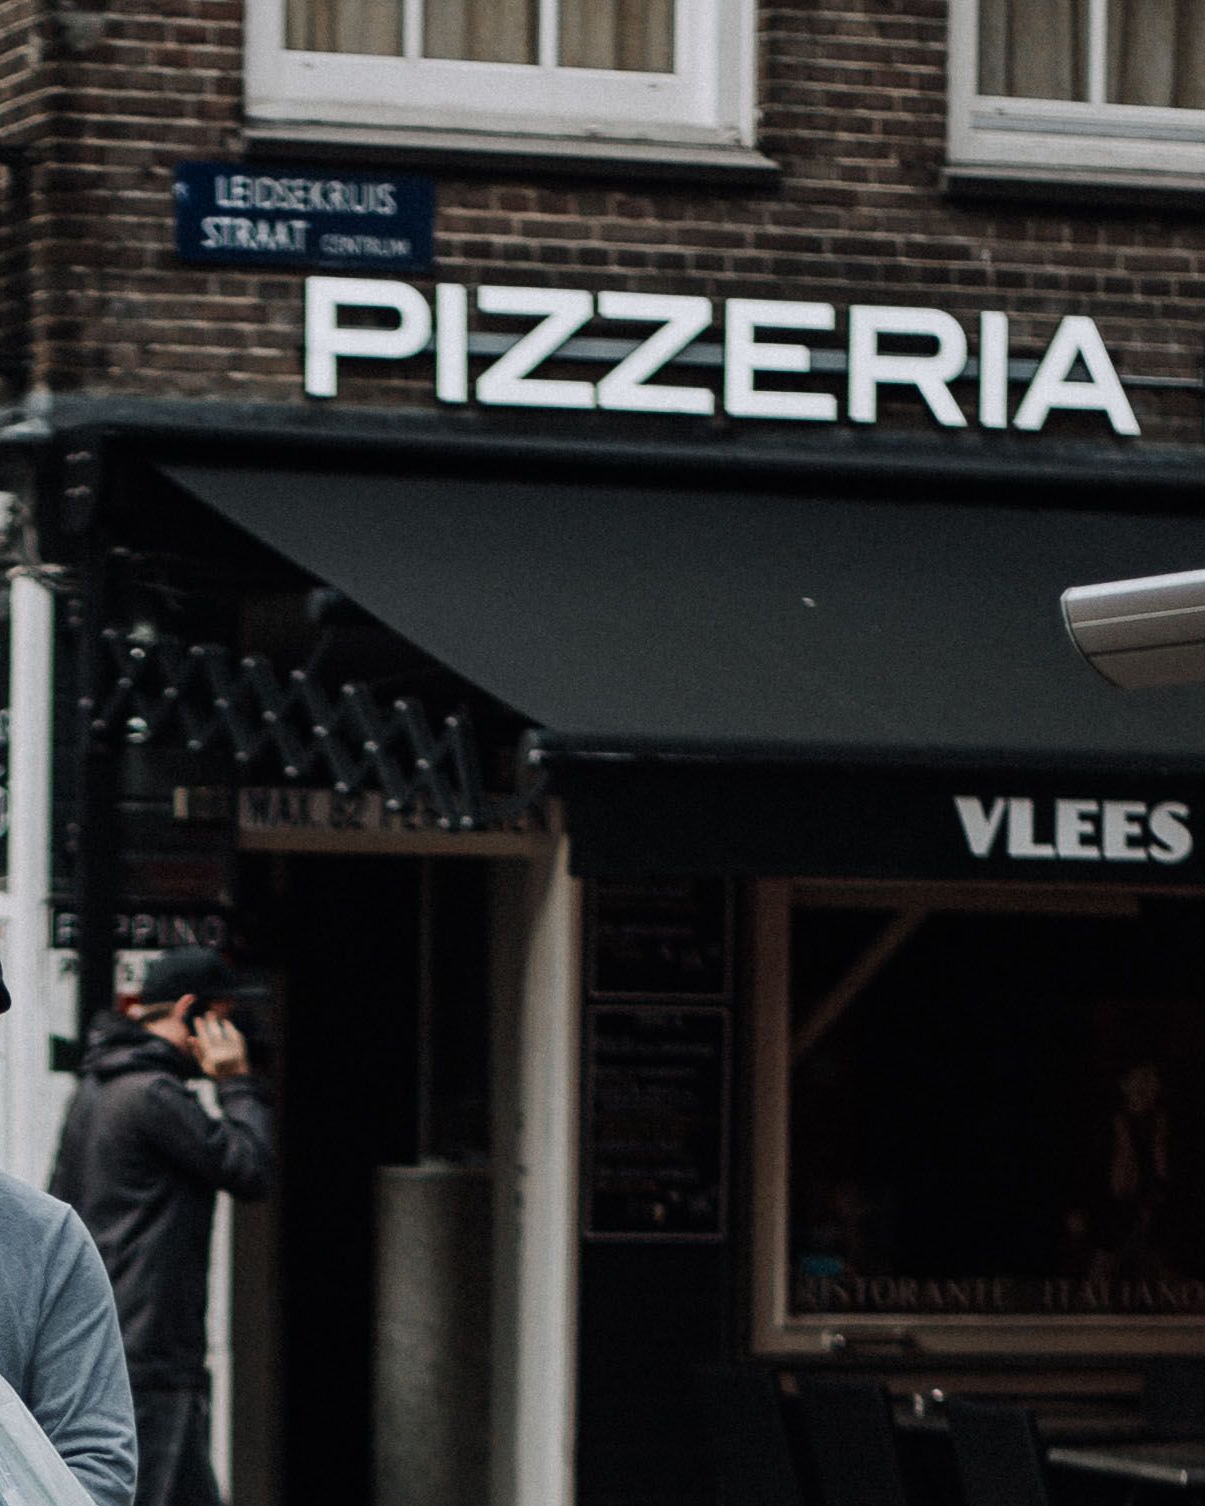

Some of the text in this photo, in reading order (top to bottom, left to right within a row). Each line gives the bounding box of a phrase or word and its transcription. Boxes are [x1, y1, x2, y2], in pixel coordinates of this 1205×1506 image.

[214, 175, 397, 216] LEIDSEKRUIS
[200, 216, 312, 250] STRAAT
[303, 274, 1143, 437] PIZZERIA
[953, 796, 1193, 864] VLEES
